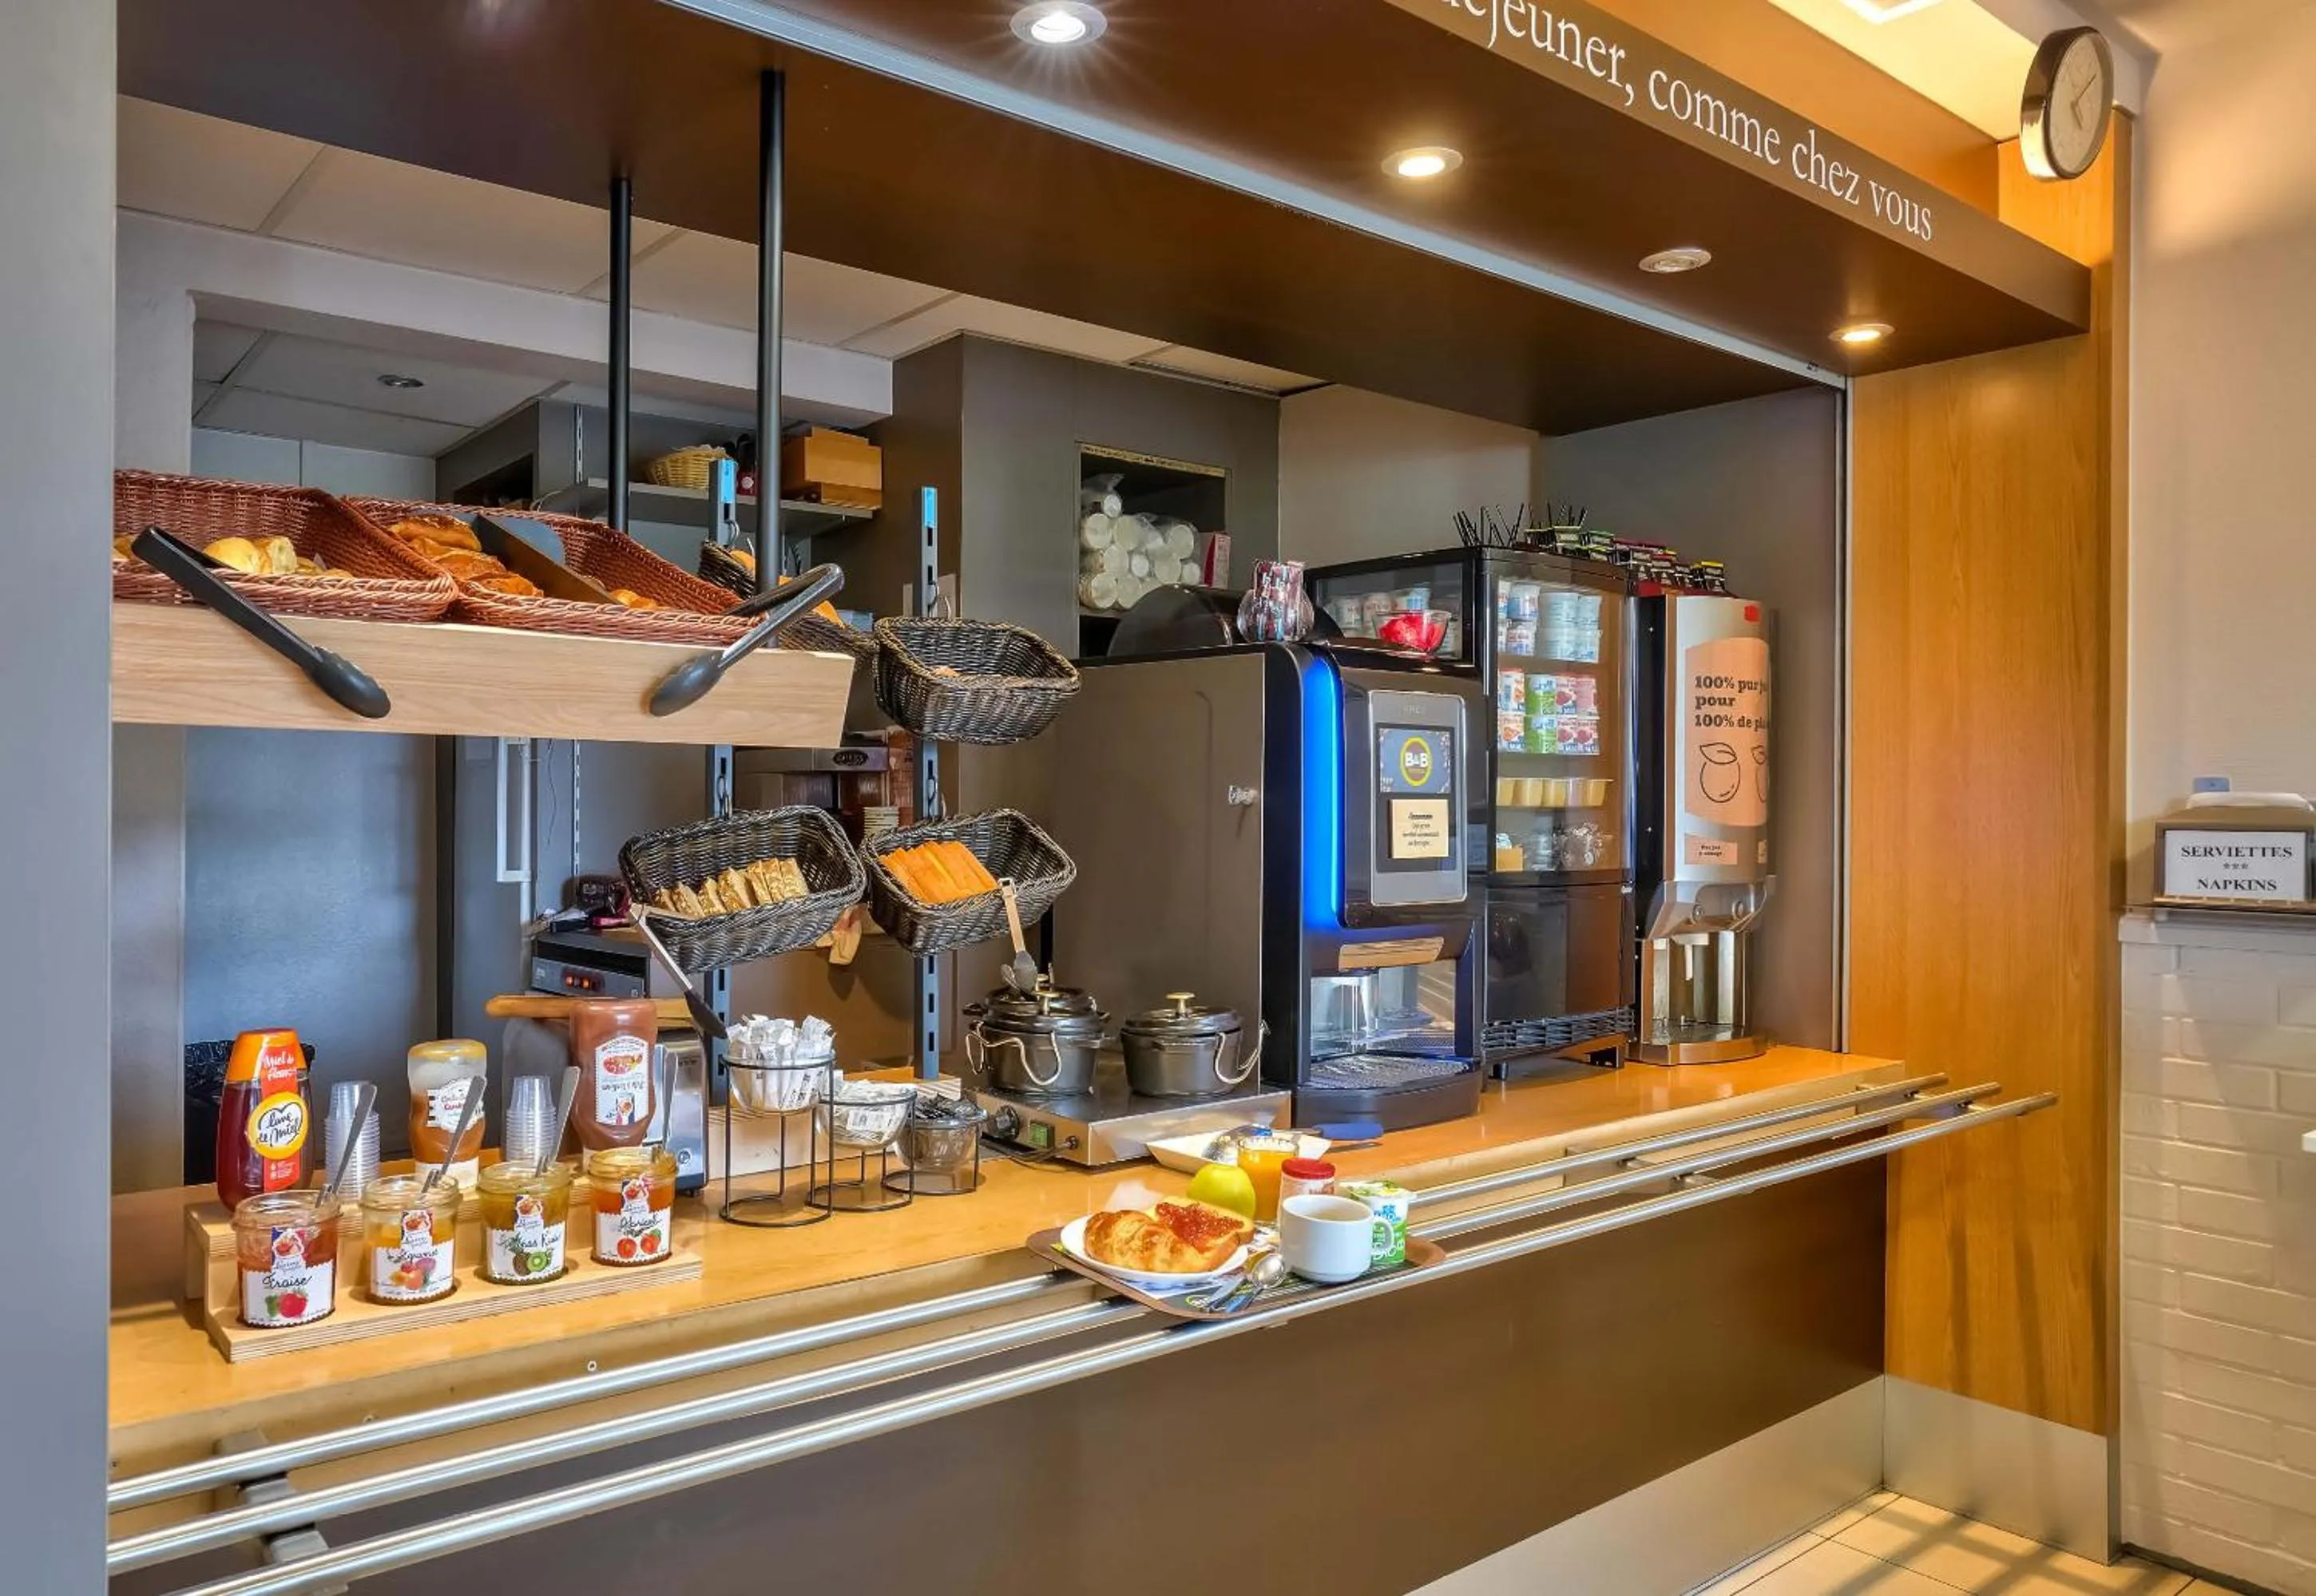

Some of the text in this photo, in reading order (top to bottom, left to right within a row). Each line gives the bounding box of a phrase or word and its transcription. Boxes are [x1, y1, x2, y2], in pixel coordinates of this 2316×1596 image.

[1442, 0, 1932, 241] jeuner, comme chez vous
[1695, 675, 1735, 689] 100%
[1695, 696, 1735, 711] pour
[1695, 714, 1735, 727] 100%
[1738, 715, 1752, 728] de
[2180, 846, 2293, 858] SERVIETTES
[2197, 879, 2277, 892] NAPKINS
[262, 1271, 313, 1289] Fraise
